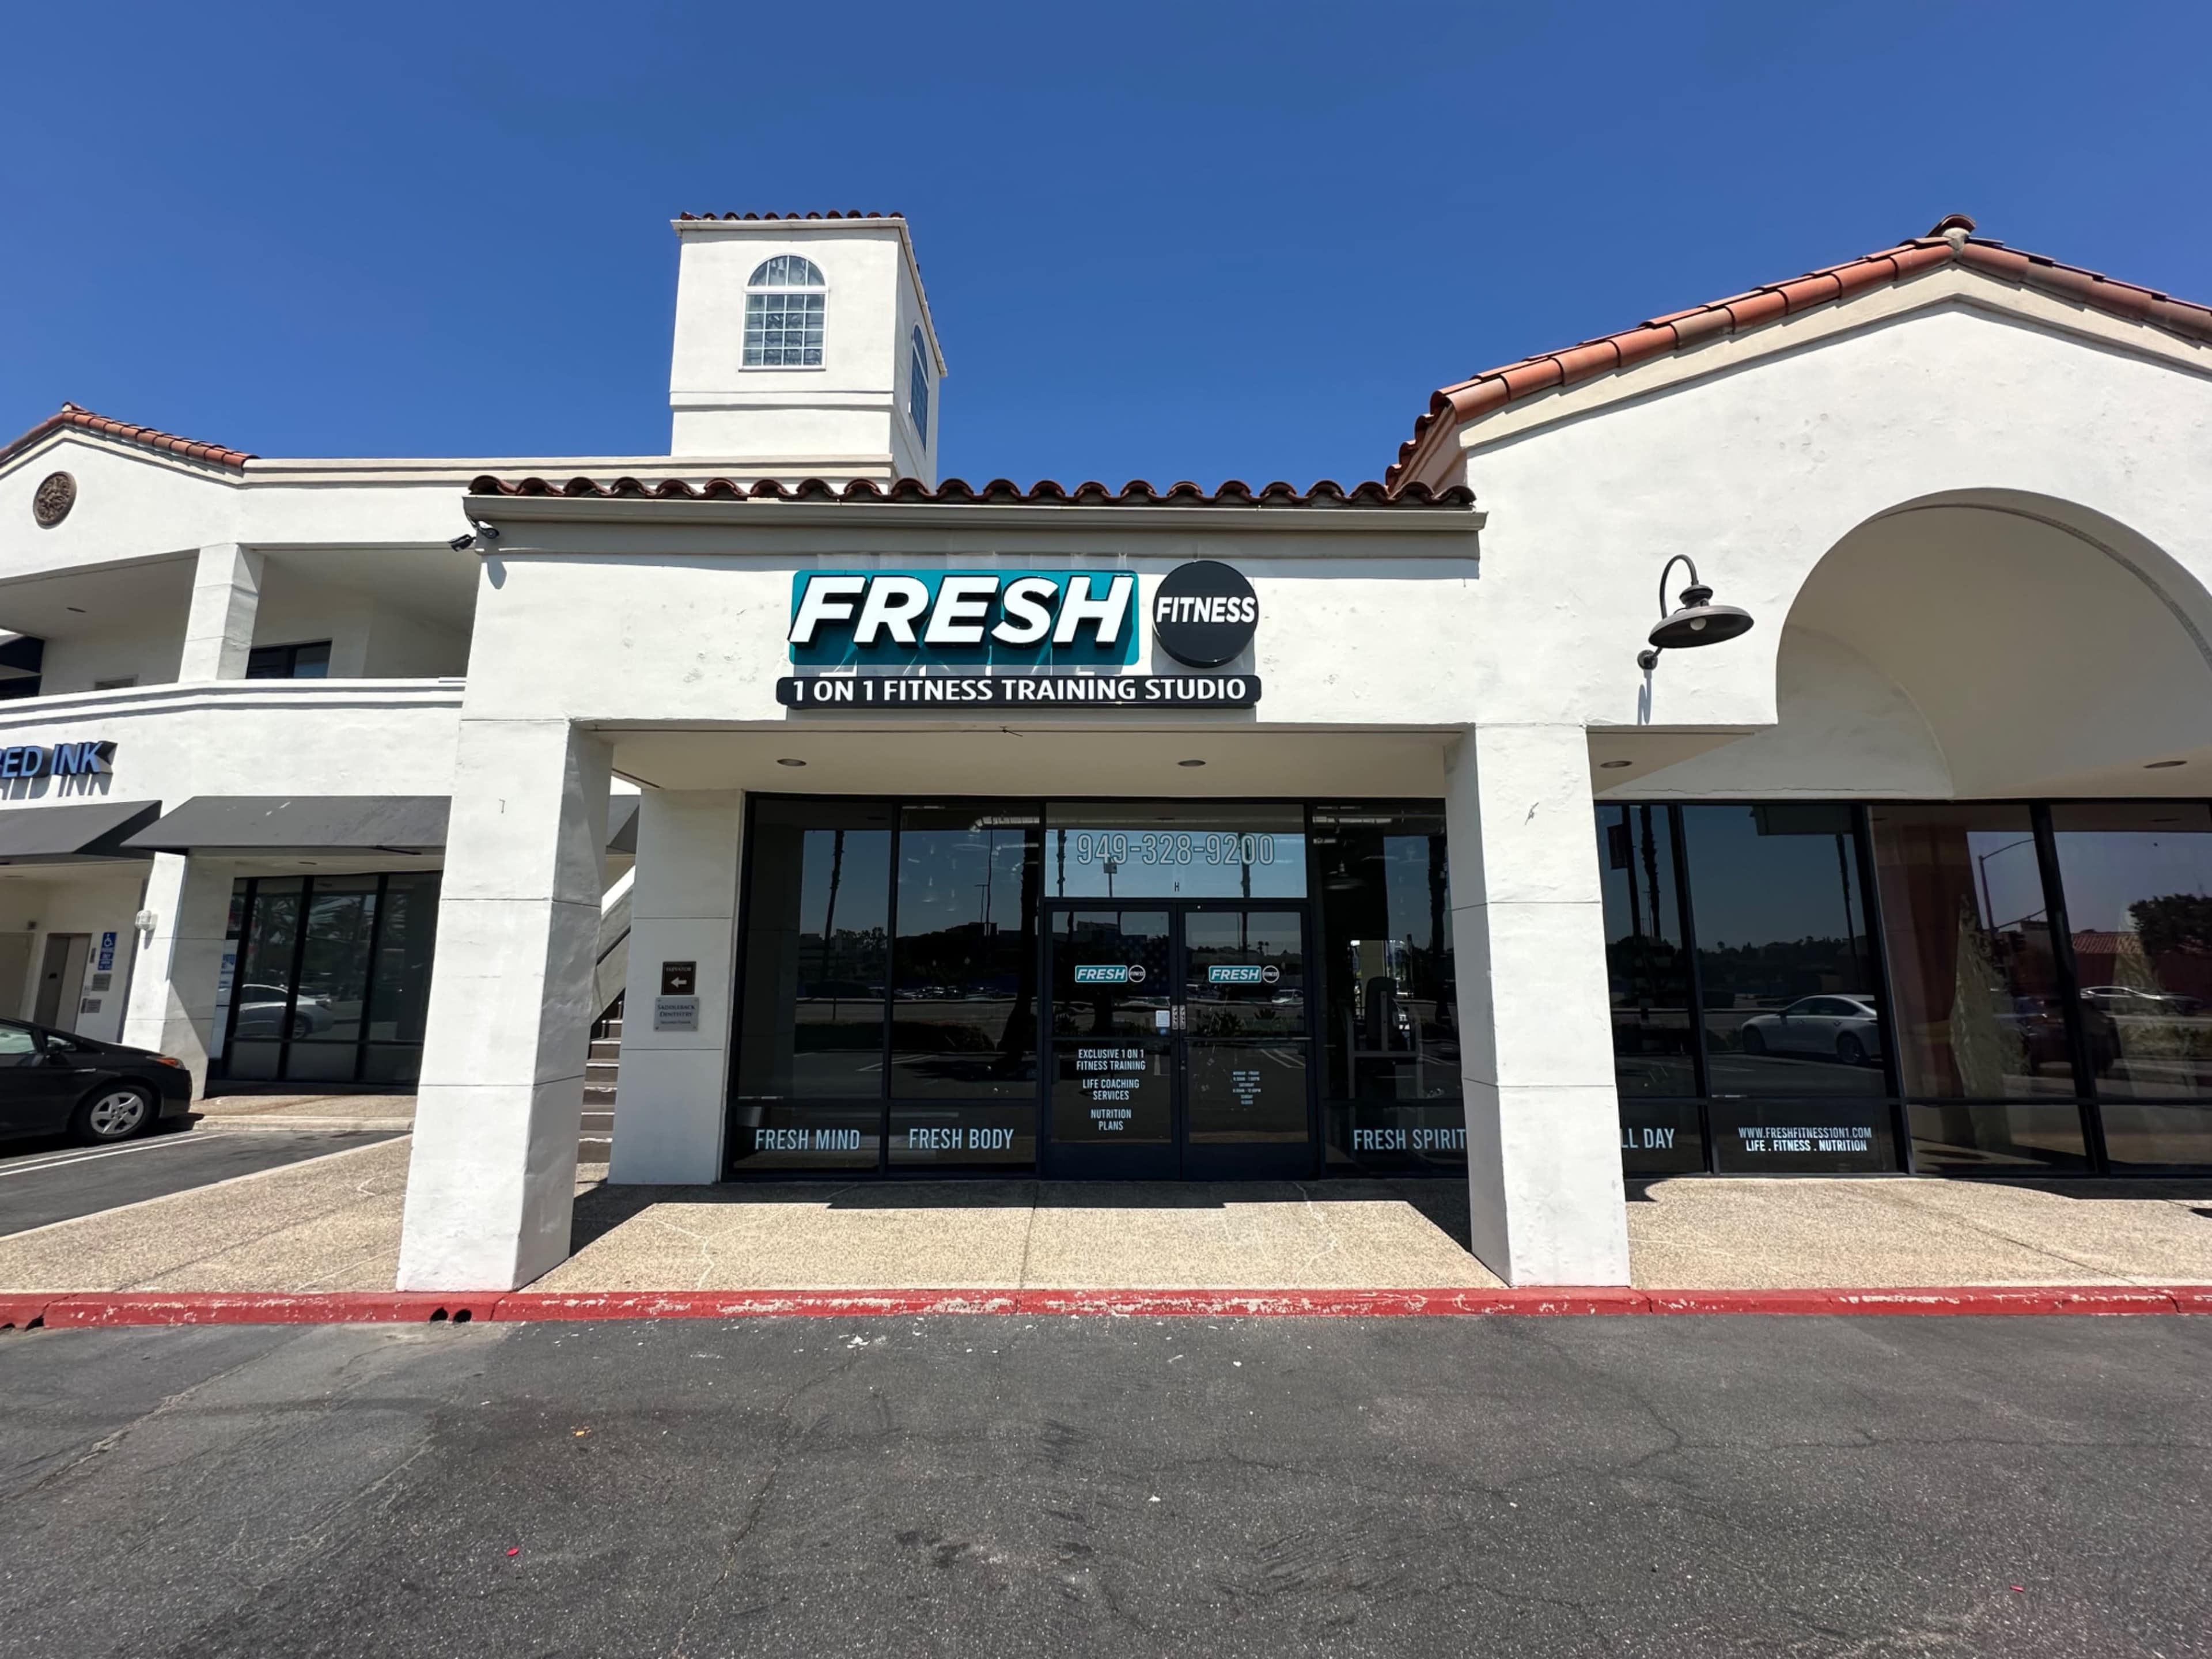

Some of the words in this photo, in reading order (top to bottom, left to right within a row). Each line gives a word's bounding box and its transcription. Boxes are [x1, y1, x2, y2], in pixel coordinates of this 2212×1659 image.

[789, 575, 1134, 645] FRESH
[1156, 596, 1256, 624] FITNESS
[793, 680, 804, 700] 1
[813, 680, 854, 700] ON
[863, 680, 874, 700] 1
[884, 679, 993, 700] FITNESS
[1003, 679, 1137, 700] TRAINING
[1145, 679, 1246, 700] STUDIO
[50, 741, 104, 775] INK
[1077, 833, 1275, 865] 949-328-9200
[1174, 881, 1180, 892] H
[1077, 968, 1126, 980] FRESH
[1211, 969, 1259, 980] FRESH
[1078, 1049, 1119, 1059] EXCLUSIVE
[1121, 1049, 1126, 1059] 1
[1127, 1049, 1138, 1059] ON
[1140, 1049, 1144, 1059] 1
[1076, 1060, 1108, 1070] FITNESS
[1109, 1060, 1146, 1070] TRAINING
[1082, 1079, 1099, 1089] LIFE
[1101, 1079, 1140, 1089] COACHING
[1093, 1090, 1130, 1100] SERVICES
[1090, 1108, 1132, 1119] NUTRITION
[1098, 1120, 1124, 1131] PLANS
[909, 1128, 963, 1149] FRESH
[969, 1128, 1014, 1149] BODY
[1353, 1129, 1407, 1150] FRESH
[1413, 1128, 1467, 1149] SPIRIT
[1620, 1127, 1639, 1149] LL
[1643, 1127, 1675, 1149] DAY
[1738, 1127, 1872, 1139] WWW.FRESHFITNESS1ON1.COM
[755, 1129, 808, 1150] FRESH
[815, 1129, 861, 1150] MIND
[1745, 1139, 1766, 1152] LIFE
[1774, 1139, 1811, 1152] FITNESS
[1819, 1139, 1868, 1152] NUTRITION
